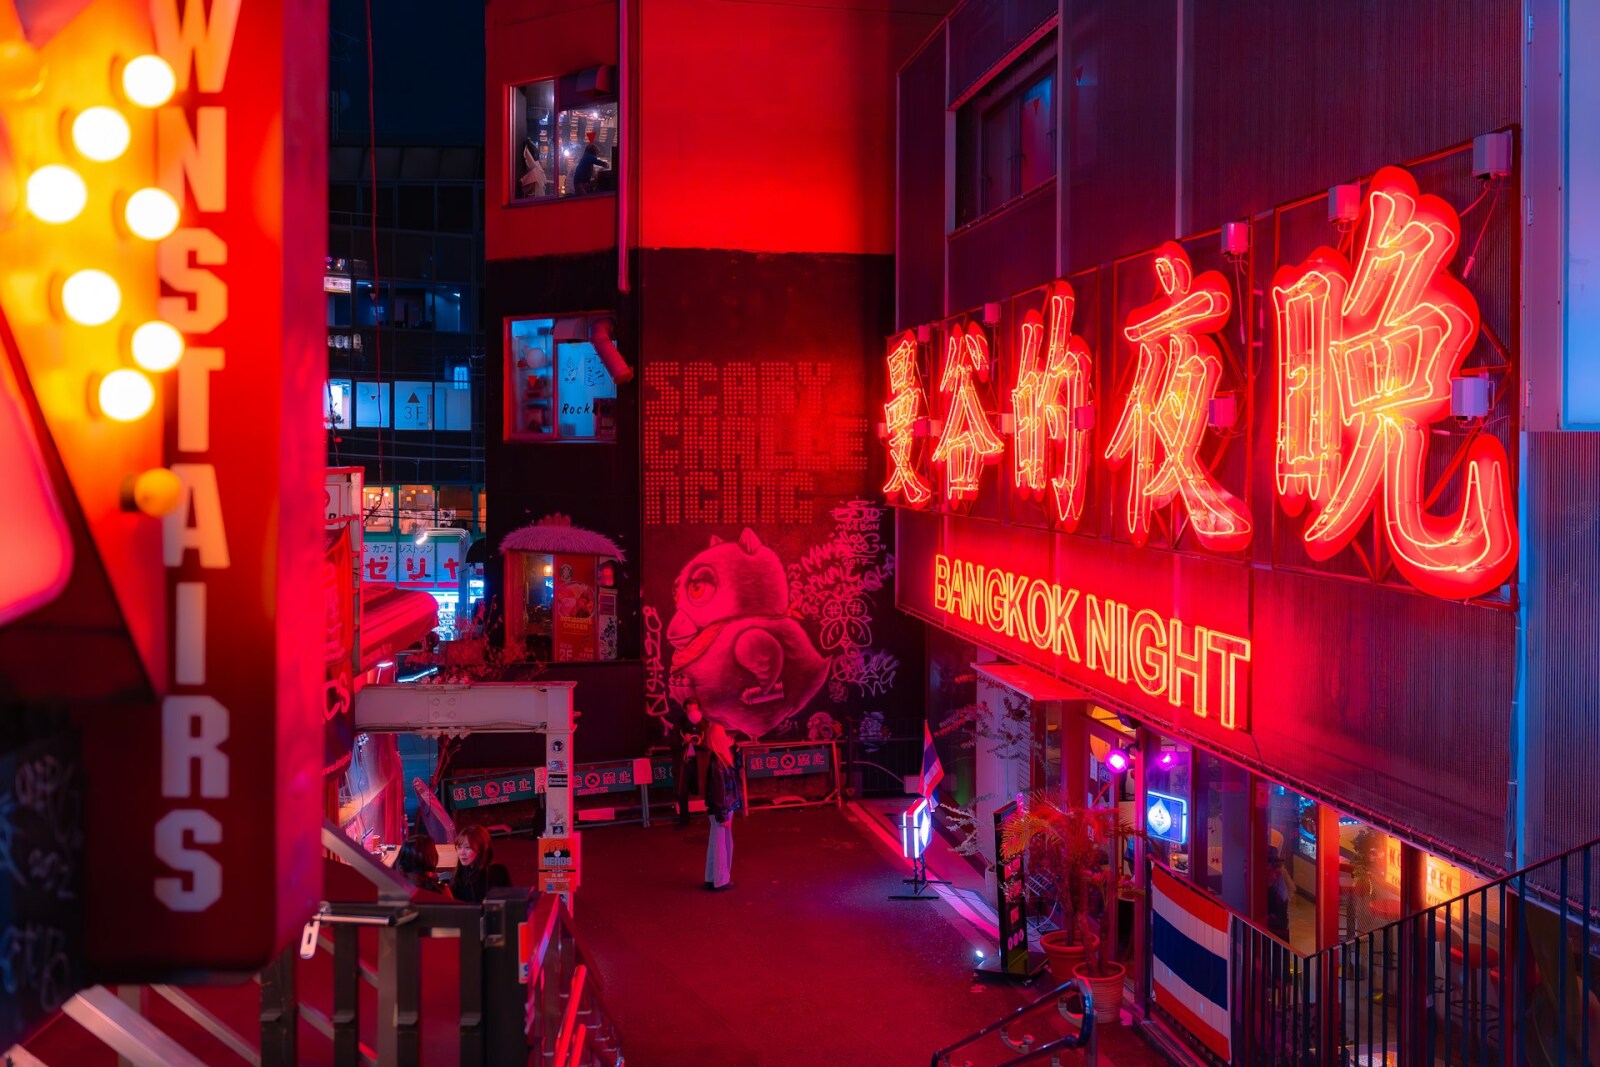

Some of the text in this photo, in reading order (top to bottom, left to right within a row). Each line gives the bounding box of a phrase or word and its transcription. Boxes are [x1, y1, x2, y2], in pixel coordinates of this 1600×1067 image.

[403, 406, 425, 420] 3F
[644, 361, 832, 415] SCARY
[884, 166, 1519, 599] 曼谷的夜晚
[934, 554, 1252, 731] BANGKOK NIGHT
